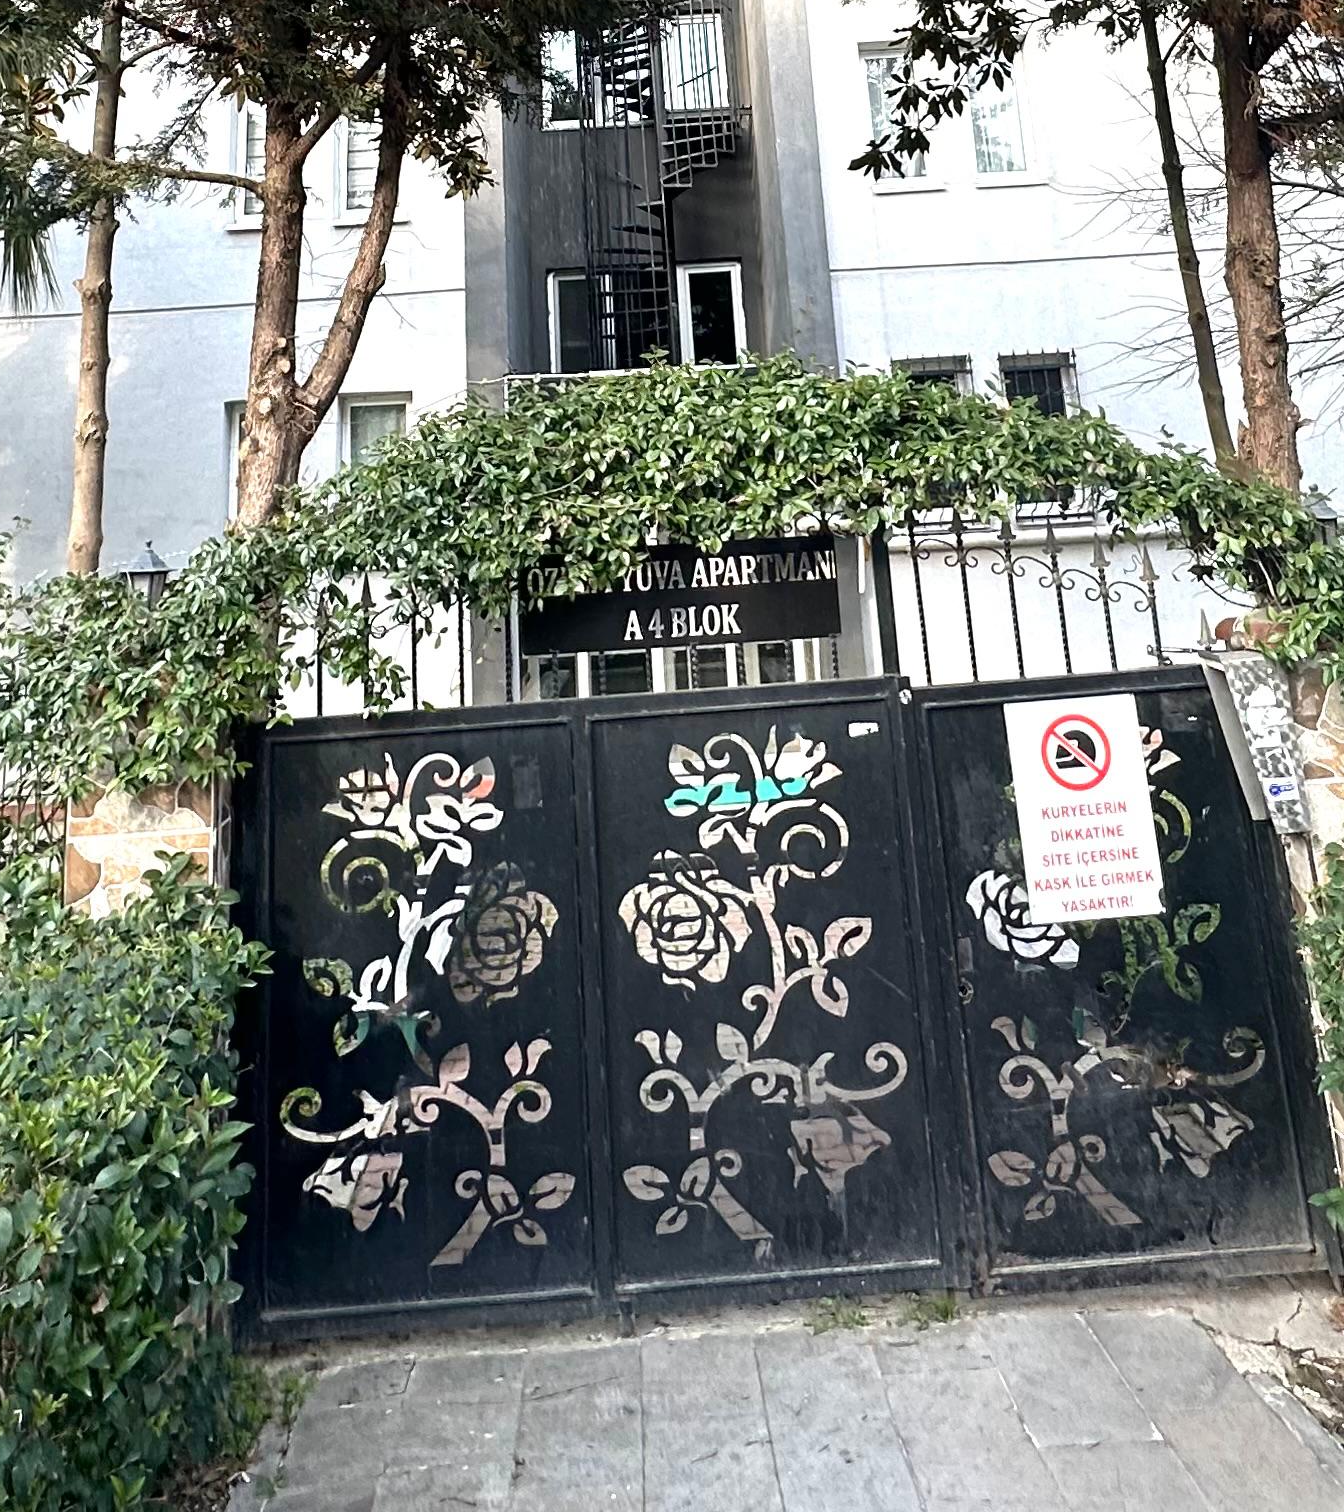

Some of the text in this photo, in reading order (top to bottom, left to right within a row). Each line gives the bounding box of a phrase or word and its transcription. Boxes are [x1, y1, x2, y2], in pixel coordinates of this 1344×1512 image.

[619, 558, 686, 592] YUVA
[623, 603, 742, 641] A 4 BLOK
[1050, 824, 1125, 843] DİKKATİNE
[1034, 876, 1072, 892] KASK
[1075, 872, 1097, 888] İLE
[1061, 895, 1134, 912] YASAKTIR!
